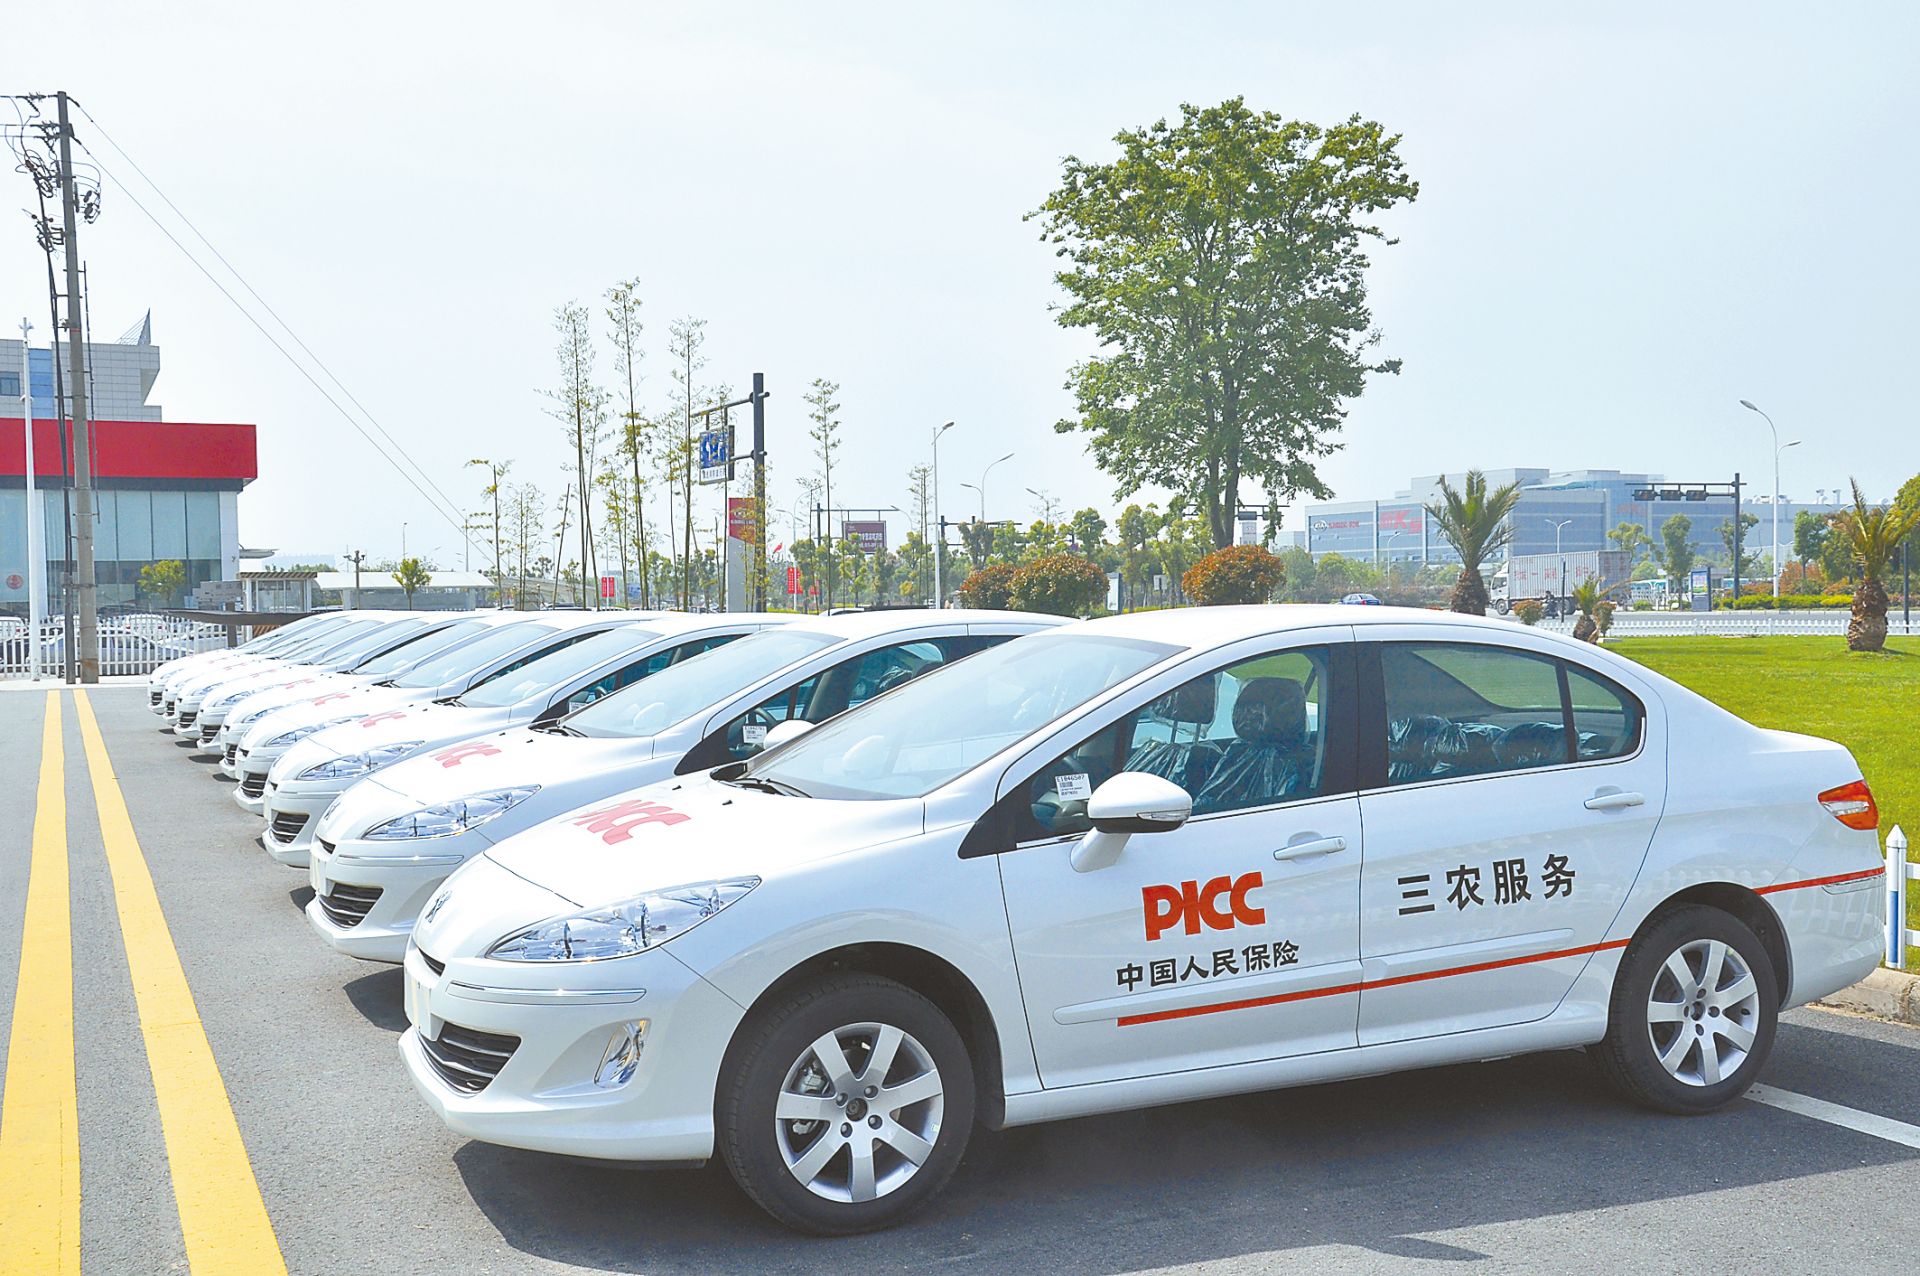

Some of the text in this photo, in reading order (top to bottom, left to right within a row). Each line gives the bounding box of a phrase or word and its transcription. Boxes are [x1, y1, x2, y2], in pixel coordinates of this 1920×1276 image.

[1142, 871, 1266, 942] PICC
[1398, 854, 1576, 916] 三农服务
[1117, 939, 1299, 992] 中国人民保险
